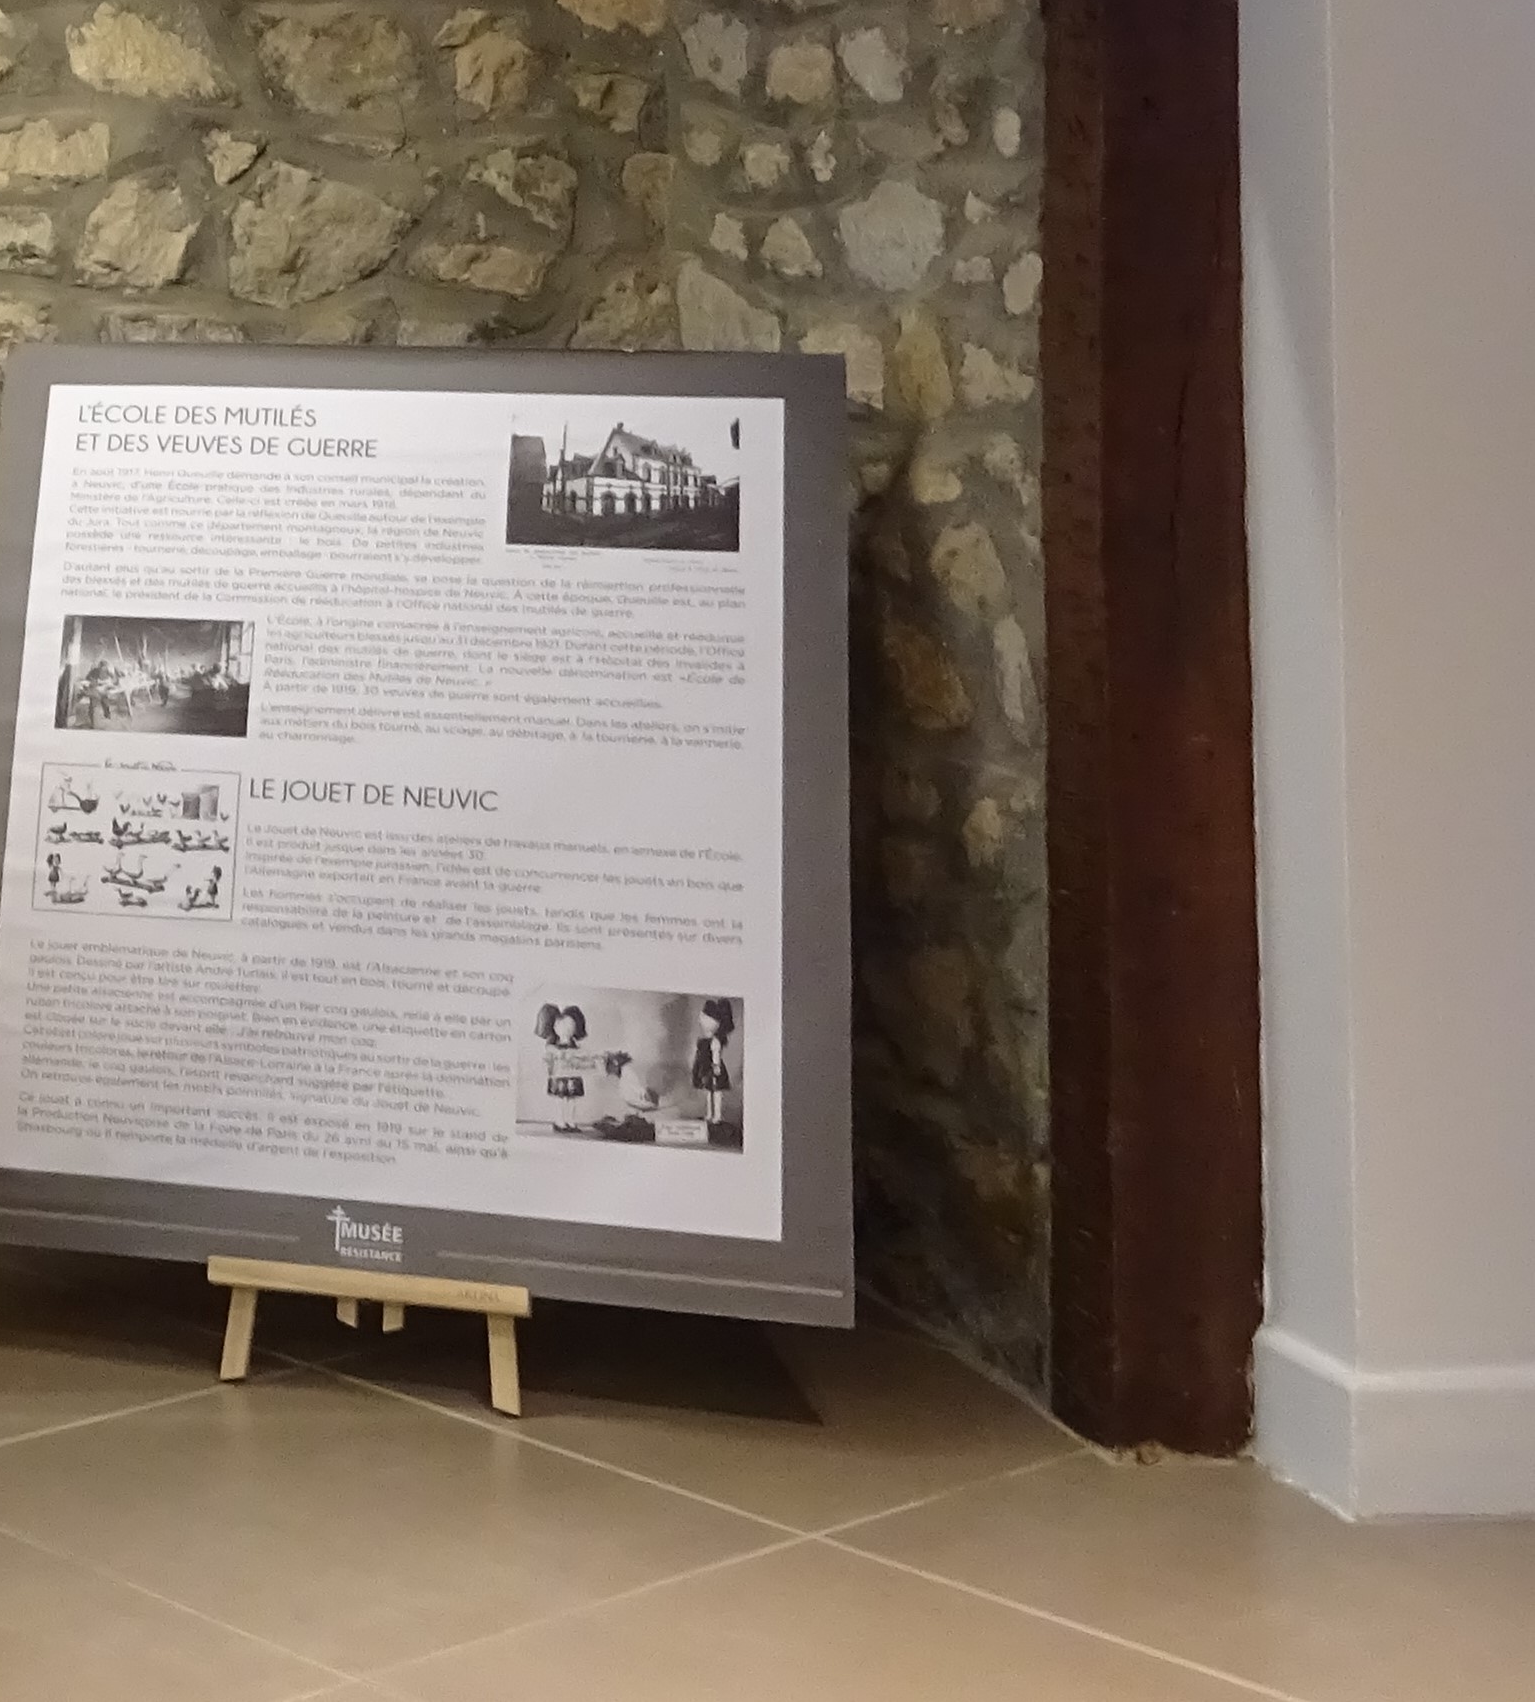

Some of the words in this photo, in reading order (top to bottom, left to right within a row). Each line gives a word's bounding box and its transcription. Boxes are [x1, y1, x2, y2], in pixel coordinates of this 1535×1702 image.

[78, 401, 167, 424] L'ÉCOLE
[174, 406, 217, 425] DES
[224, 404, 317, 427] MUTILÉS
[76, 433, 101, 452] ET
[107, 433, 149, 452] DES
[157, 434, 243, 454] VEUVES
[250, 436, 280, 455] DE
[287, 437, 378, 458] GUERRE
[249, 778, 275, 799] LE
[281, 780, 356, 804] JOUET
[363, 784, 394, 806] DE
[403, 786, 499, 812] NEUVIC
[341, 1222, 403, 1244] MUSÉE
